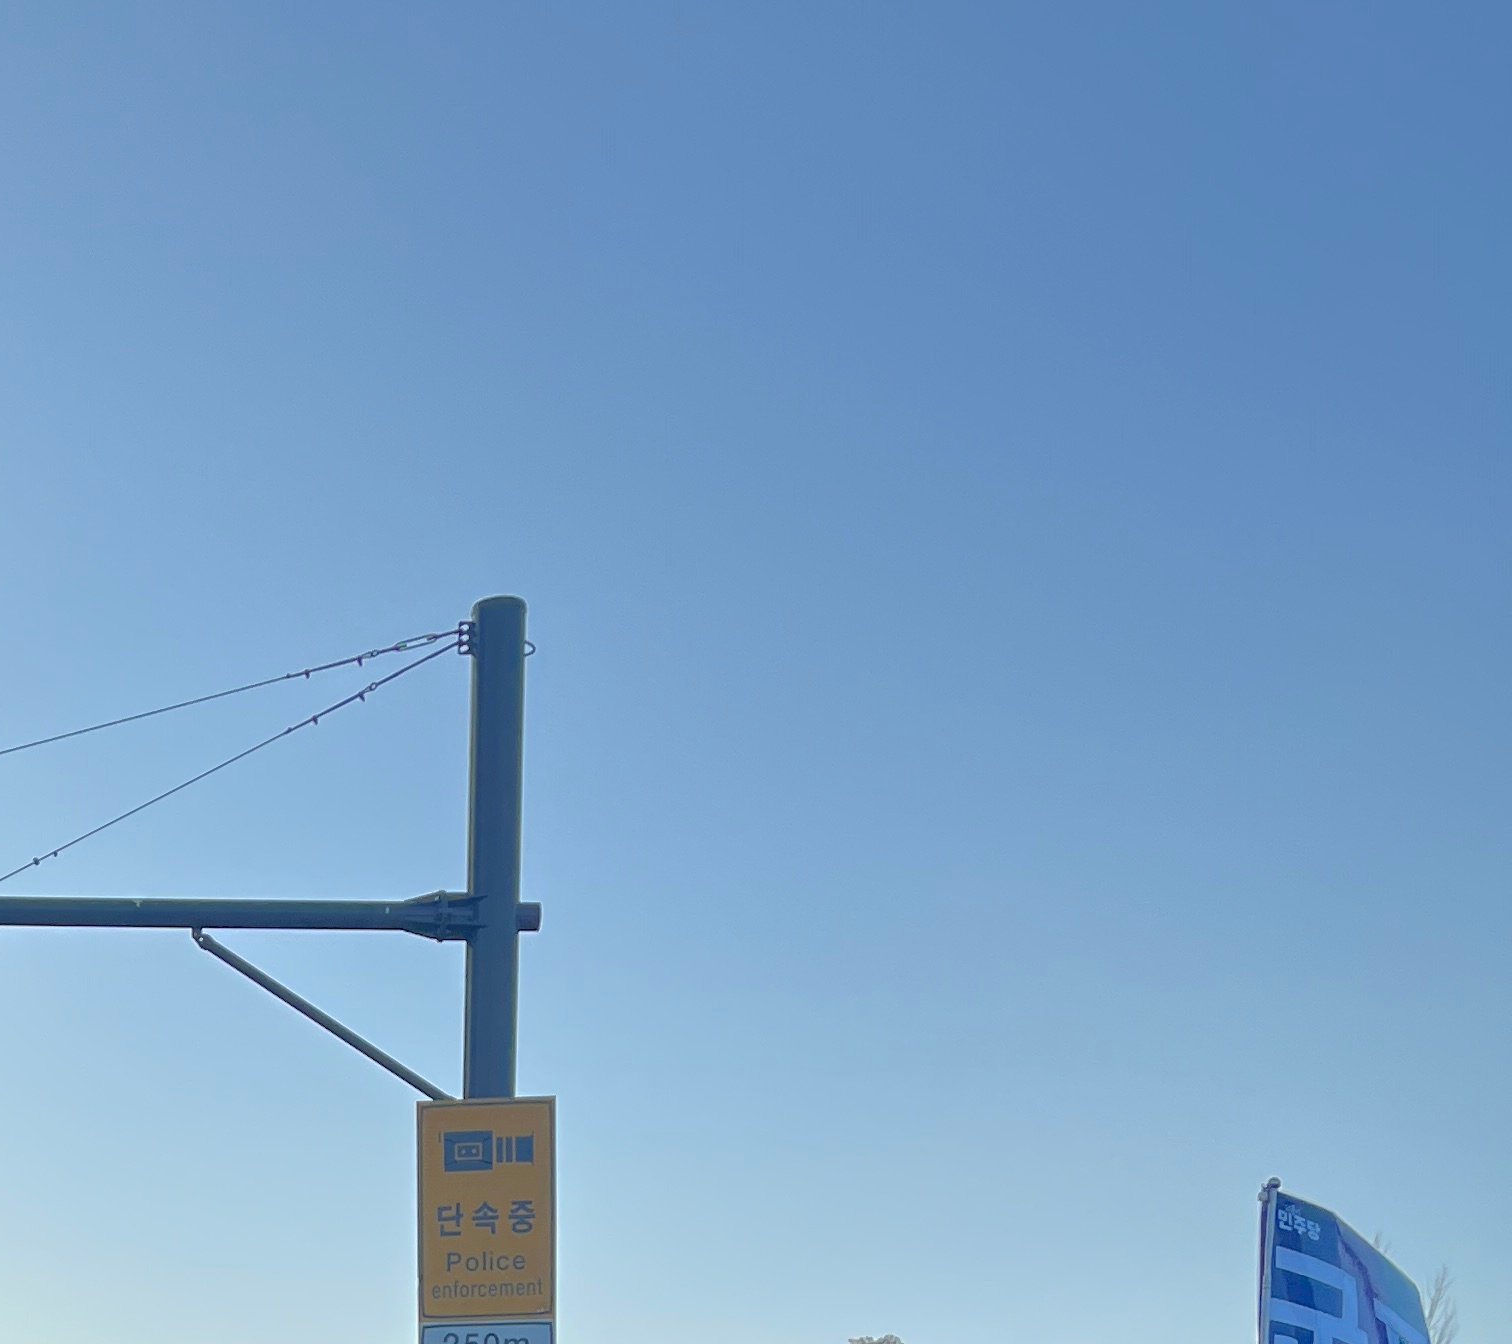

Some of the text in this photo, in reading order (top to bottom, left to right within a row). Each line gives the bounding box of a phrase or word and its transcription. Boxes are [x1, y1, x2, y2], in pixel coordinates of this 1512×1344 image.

[436, 1199, 537, 1237] 단속중
[1278, 1208, 1321, 1241] 민주당
[445, 1251, 527, 1272] Police
[431, 1279, 544, 1299] enforcement
